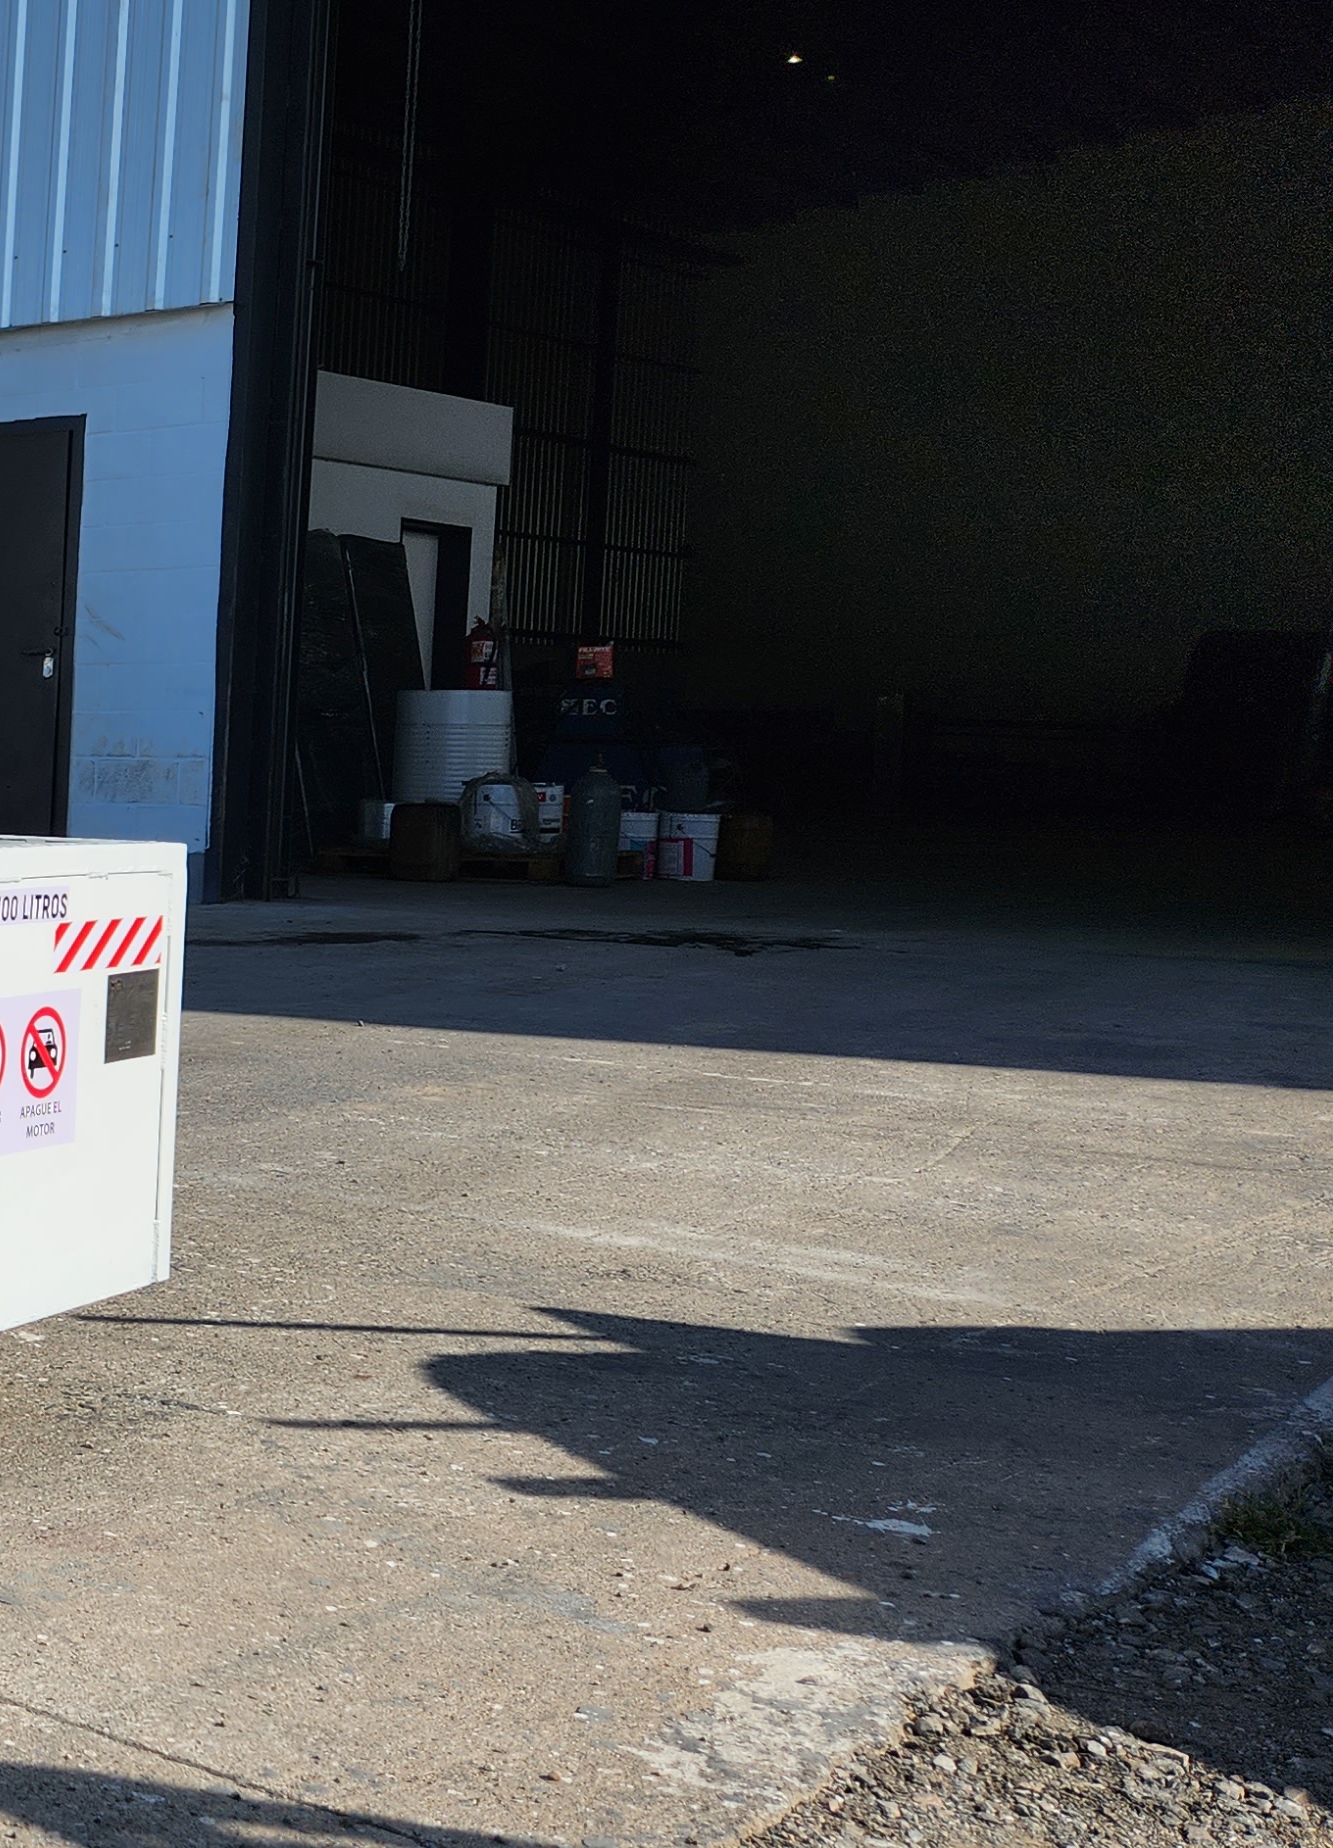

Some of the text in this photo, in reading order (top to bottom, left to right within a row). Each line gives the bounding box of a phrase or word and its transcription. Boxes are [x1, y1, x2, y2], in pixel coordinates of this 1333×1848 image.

[22, 893, 68, 920] LITROS
[20, 1101, 62, 1119] APAGUE EL
[26, 1122, 55, 1138] MOTOR
